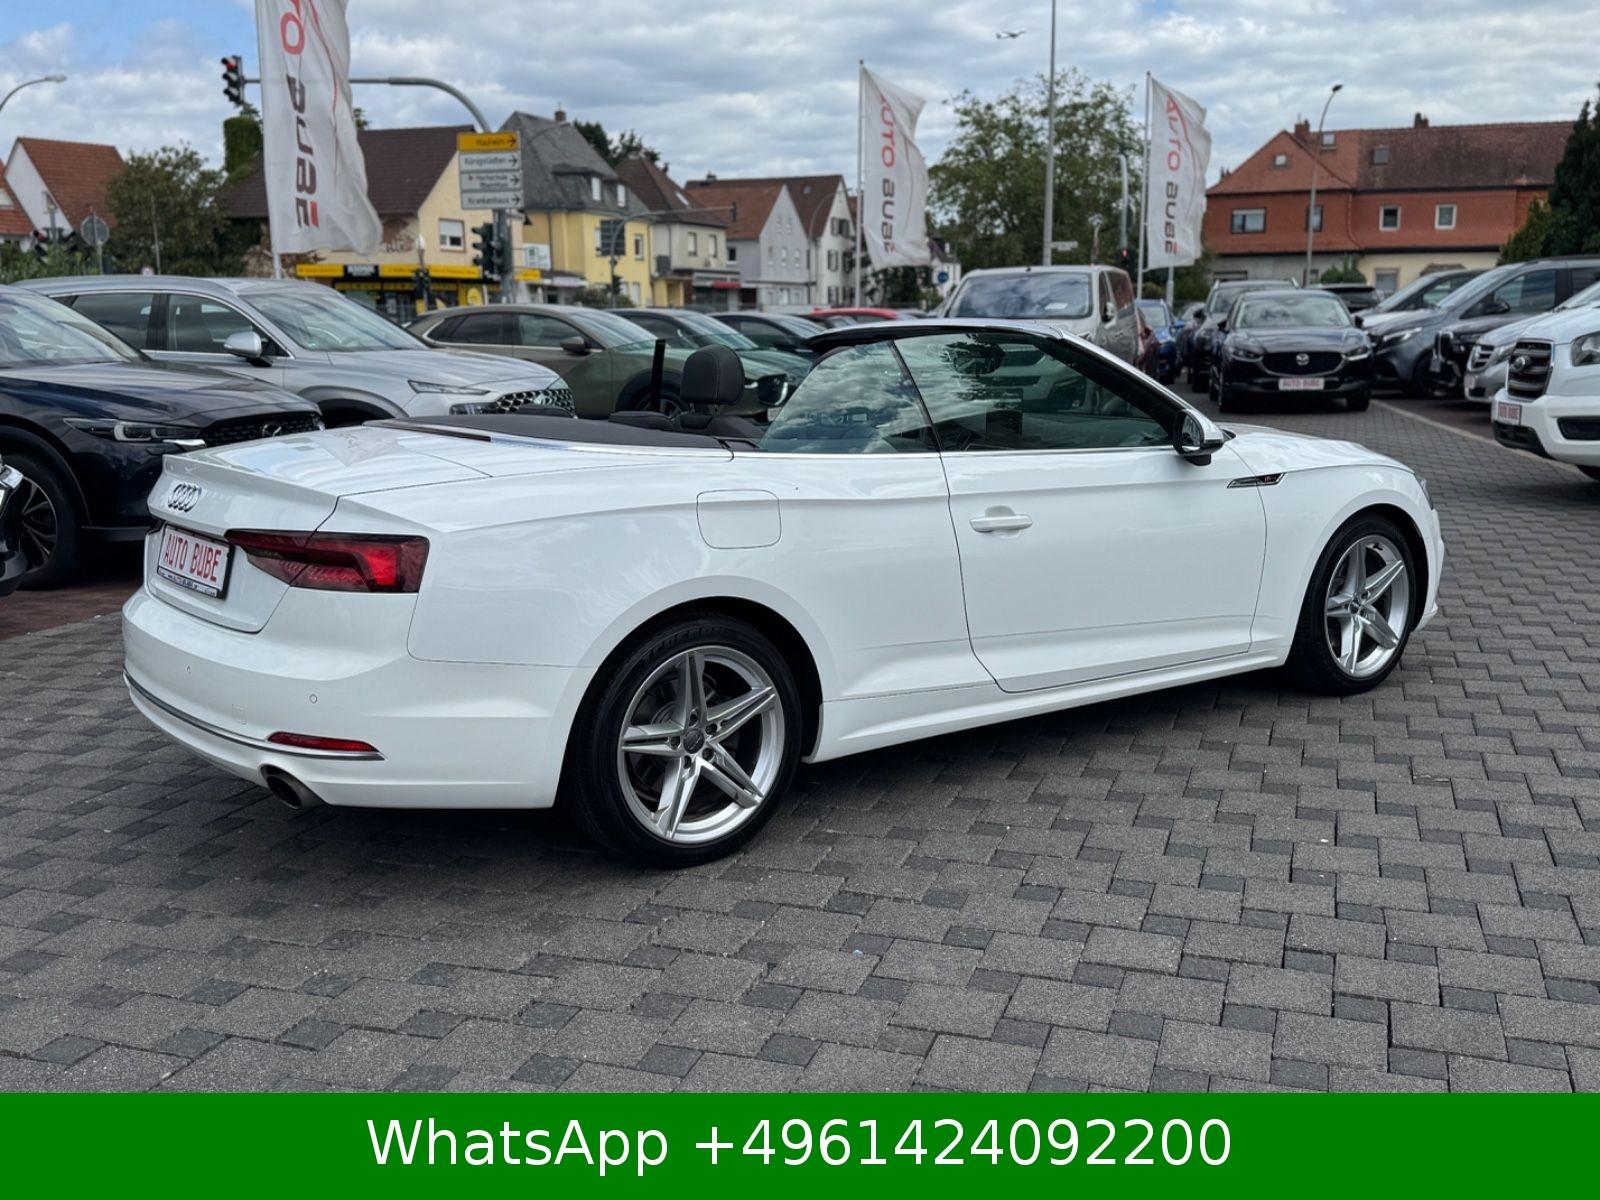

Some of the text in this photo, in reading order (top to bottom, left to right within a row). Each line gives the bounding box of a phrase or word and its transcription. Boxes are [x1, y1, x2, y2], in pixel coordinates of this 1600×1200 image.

[1164, 181, 1179, 255] BUBE
[164, 533, 222, 583] AUTO BUBE
